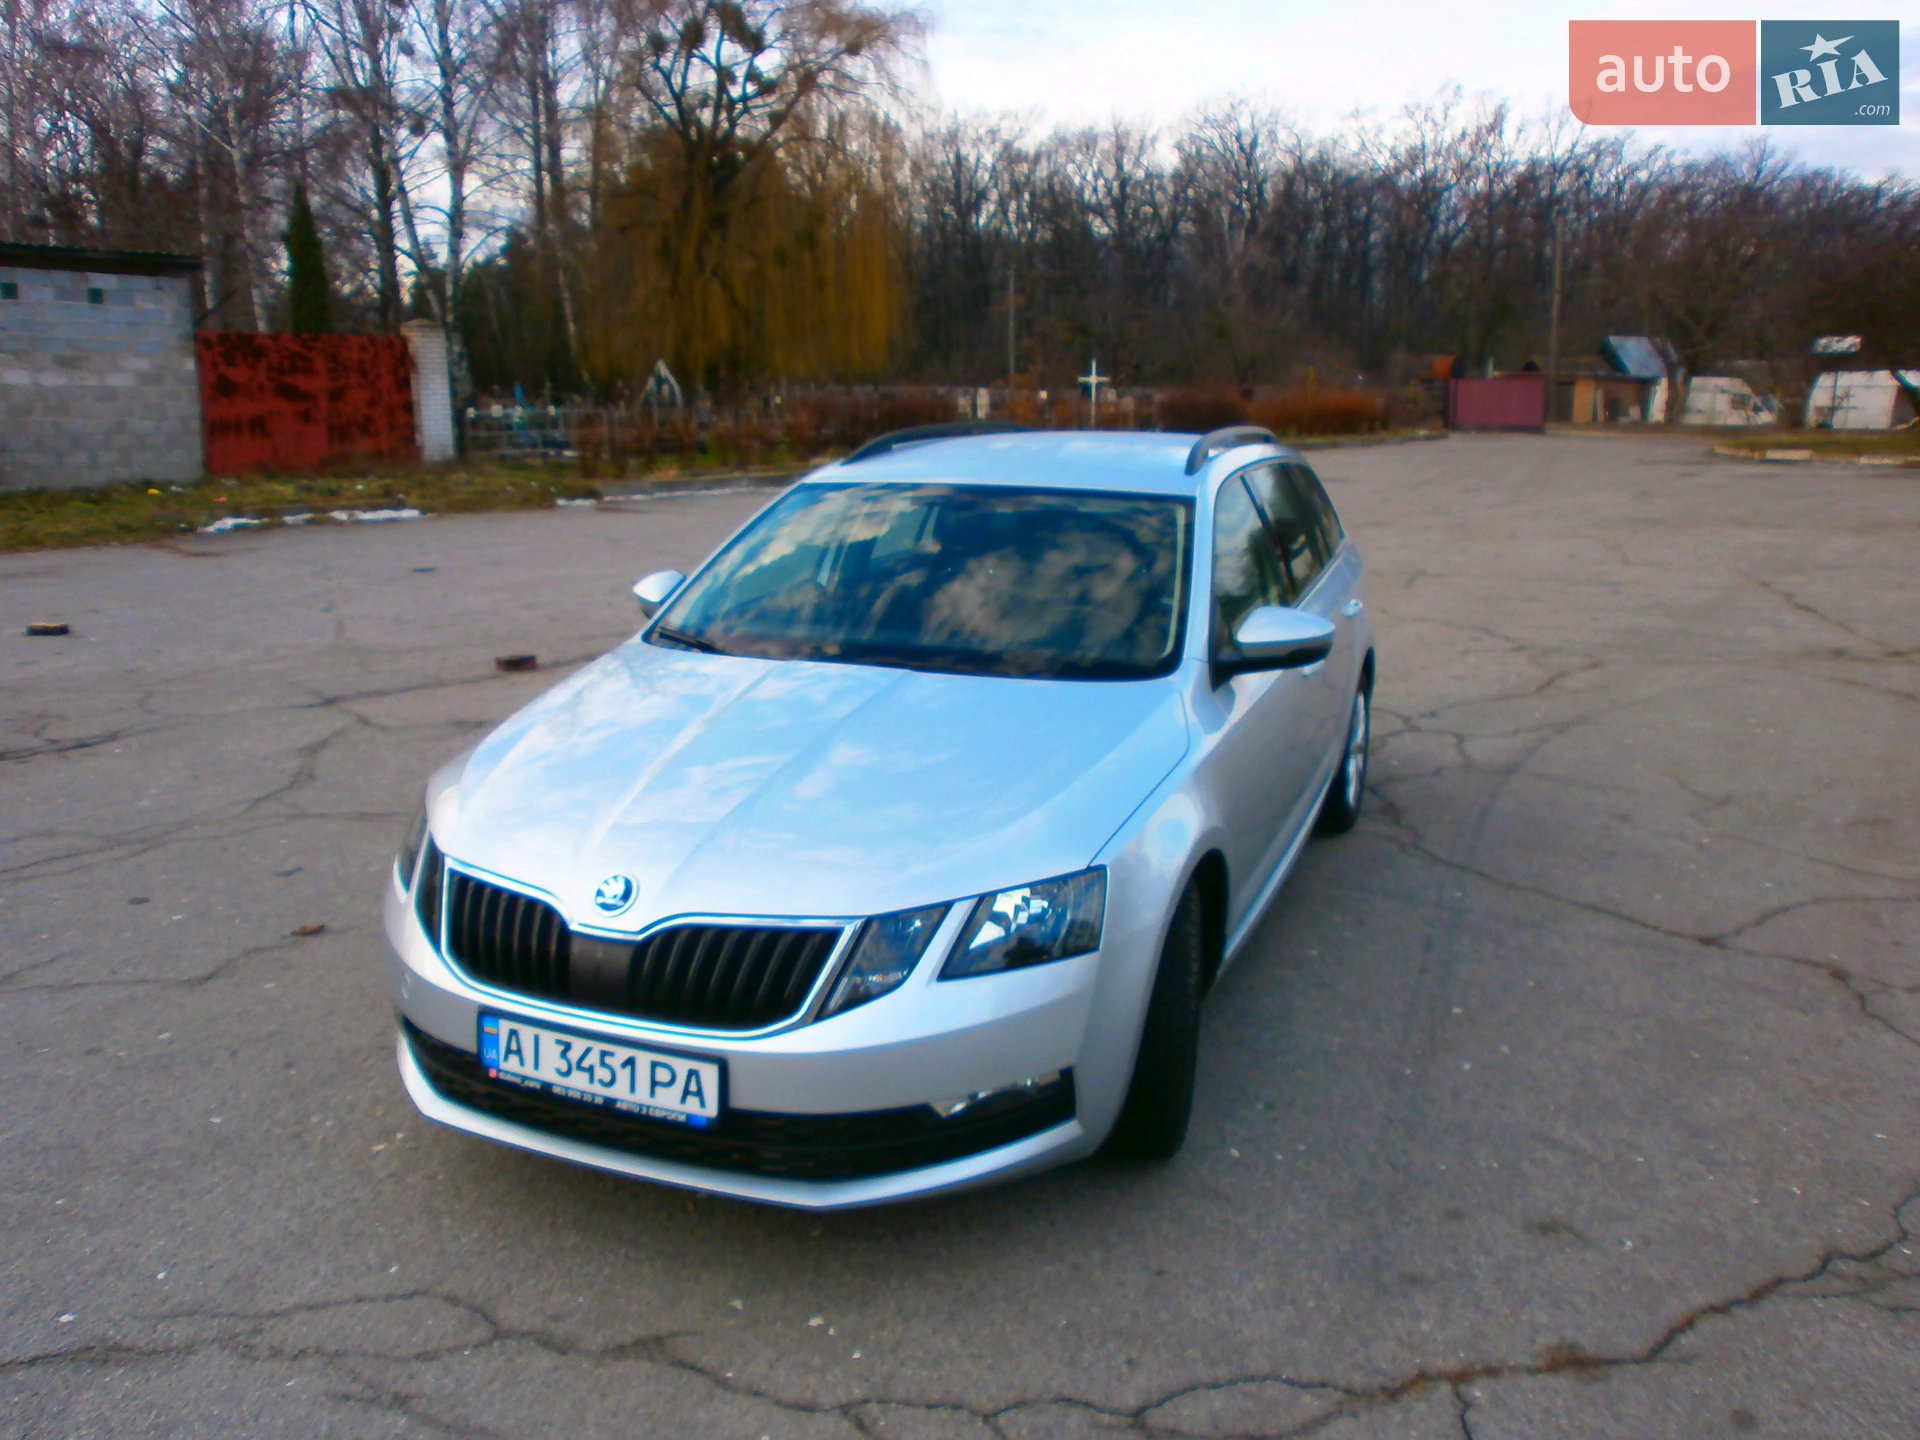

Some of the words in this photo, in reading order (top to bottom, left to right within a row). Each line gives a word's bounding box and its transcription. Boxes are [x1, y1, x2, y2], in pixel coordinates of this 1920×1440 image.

[502, 1027, 539, 1071] AI
[554, 1038, 636, 1094] 3451
[650, 1060, 706, 1109] PA
